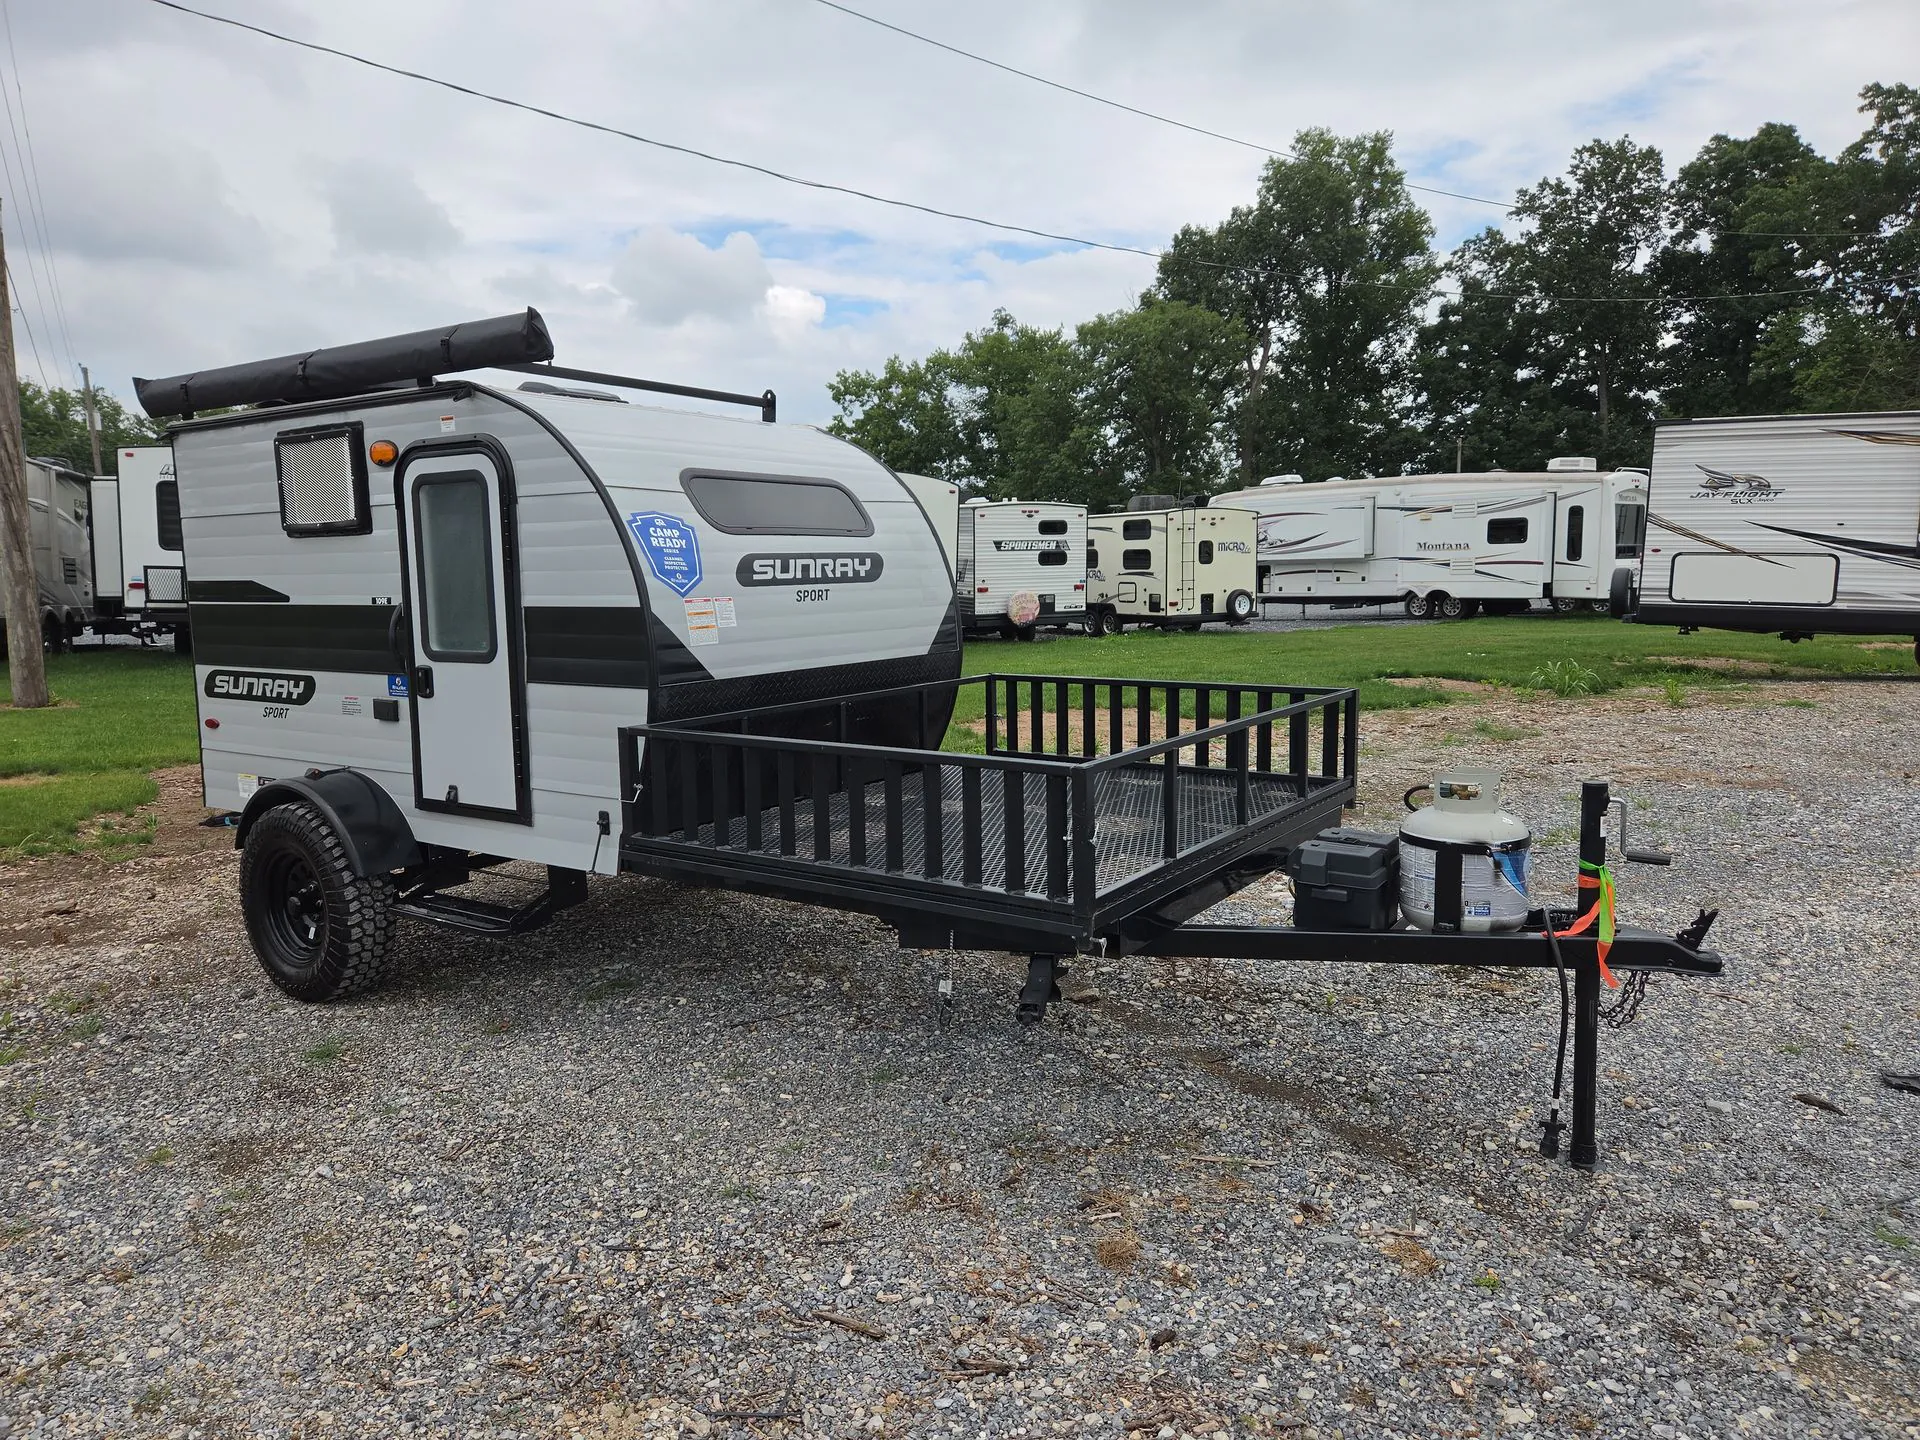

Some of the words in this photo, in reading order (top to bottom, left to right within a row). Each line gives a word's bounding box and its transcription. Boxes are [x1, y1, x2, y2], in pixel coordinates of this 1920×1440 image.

[649, 527, 680, 538] CAMP
[650, 537, 687, 549] READY
[1000, 540, 1057, 551] SPORTSMEN
[1416, 541, 1471, 551] Montana
[752, 558, 871, 580] SUNRAY
[796, 589, 830, 602] SPORT
[213, 675, 305, 699] SUNRAY
[262, 707, 289, 719] SPORT
